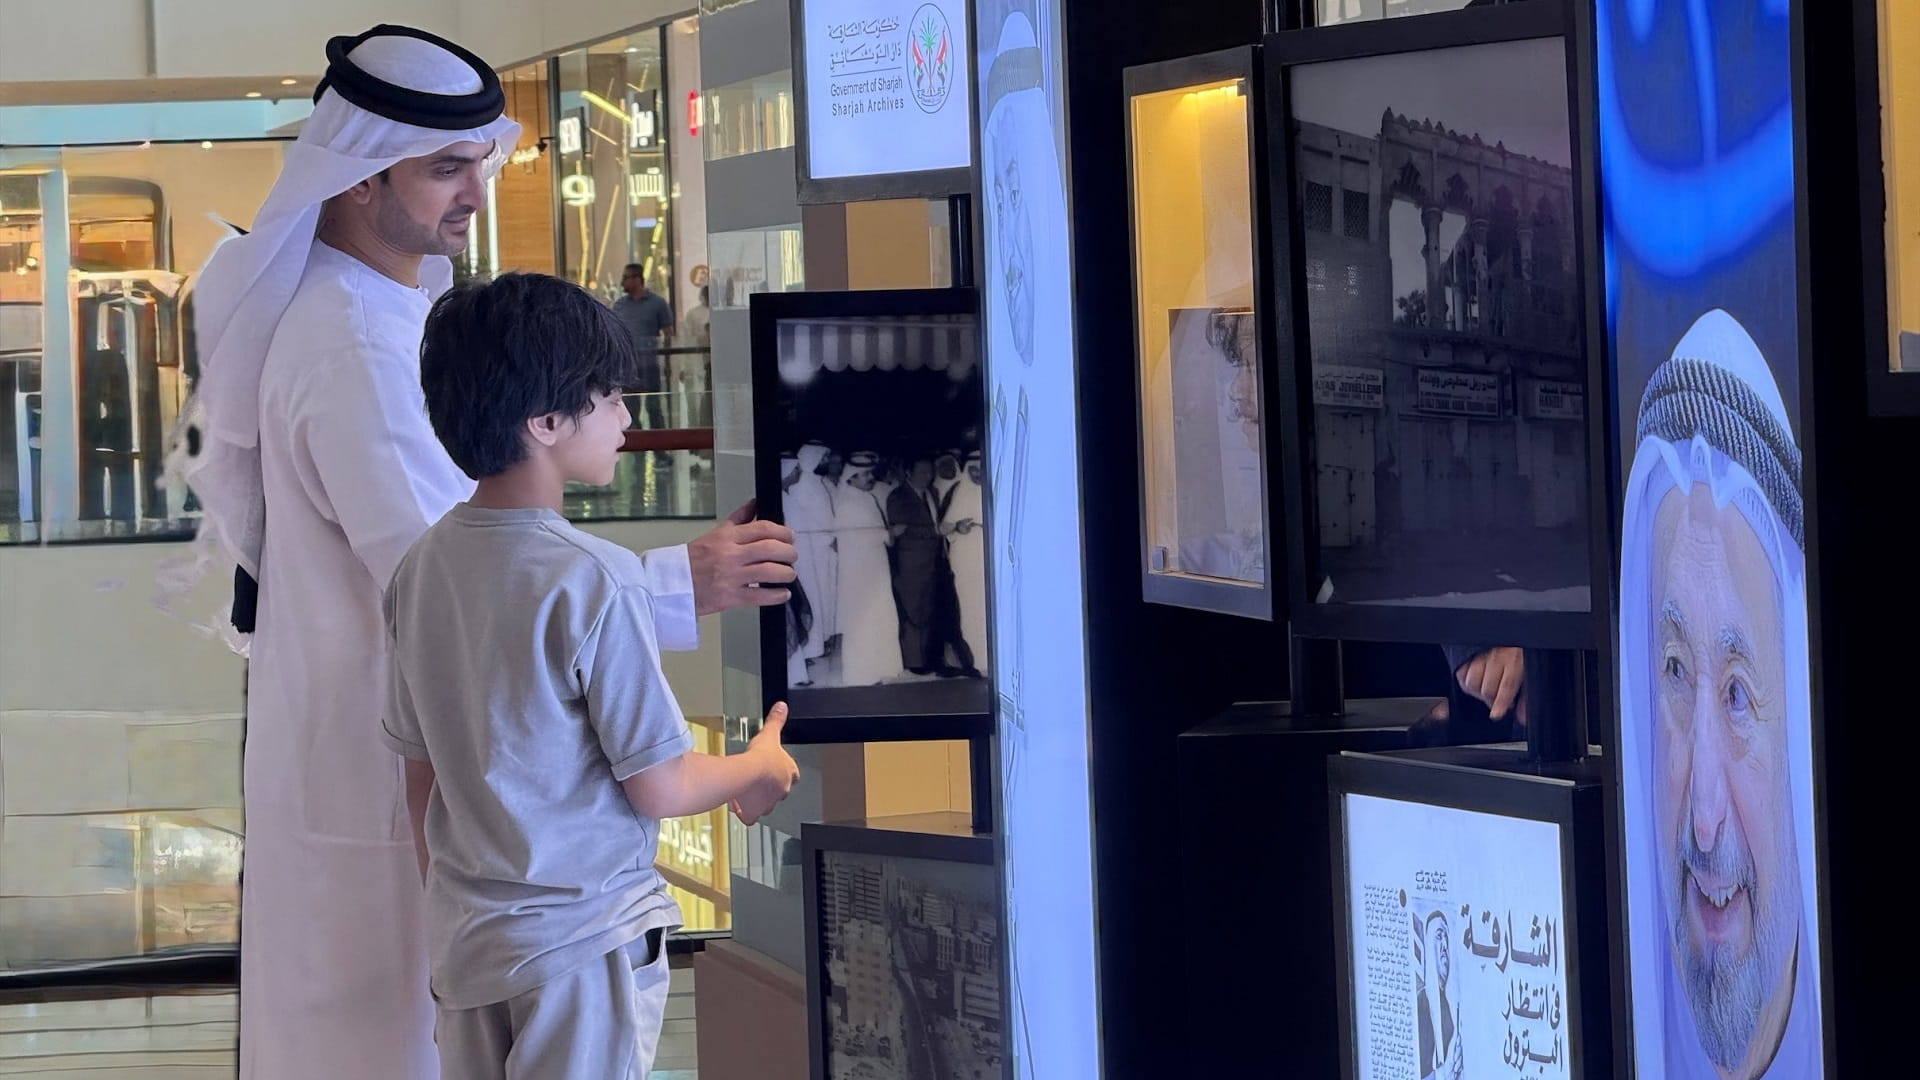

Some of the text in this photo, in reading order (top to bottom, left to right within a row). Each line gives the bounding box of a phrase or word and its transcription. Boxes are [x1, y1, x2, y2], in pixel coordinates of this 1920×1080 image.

[827, 16, 900, 43] حكومة الشارقة
[830, 41, 902, 72] دار الوثائق
[830, 75, 903, 97] Government of Sharjah
[832, 97, 904, 118] Sharjah Archives
[1461, 903, 1557, 976] الشارقة
[1502, 978, 1549, 1020] انتظار
[1503, 1023, 1562, 1073] البترول
